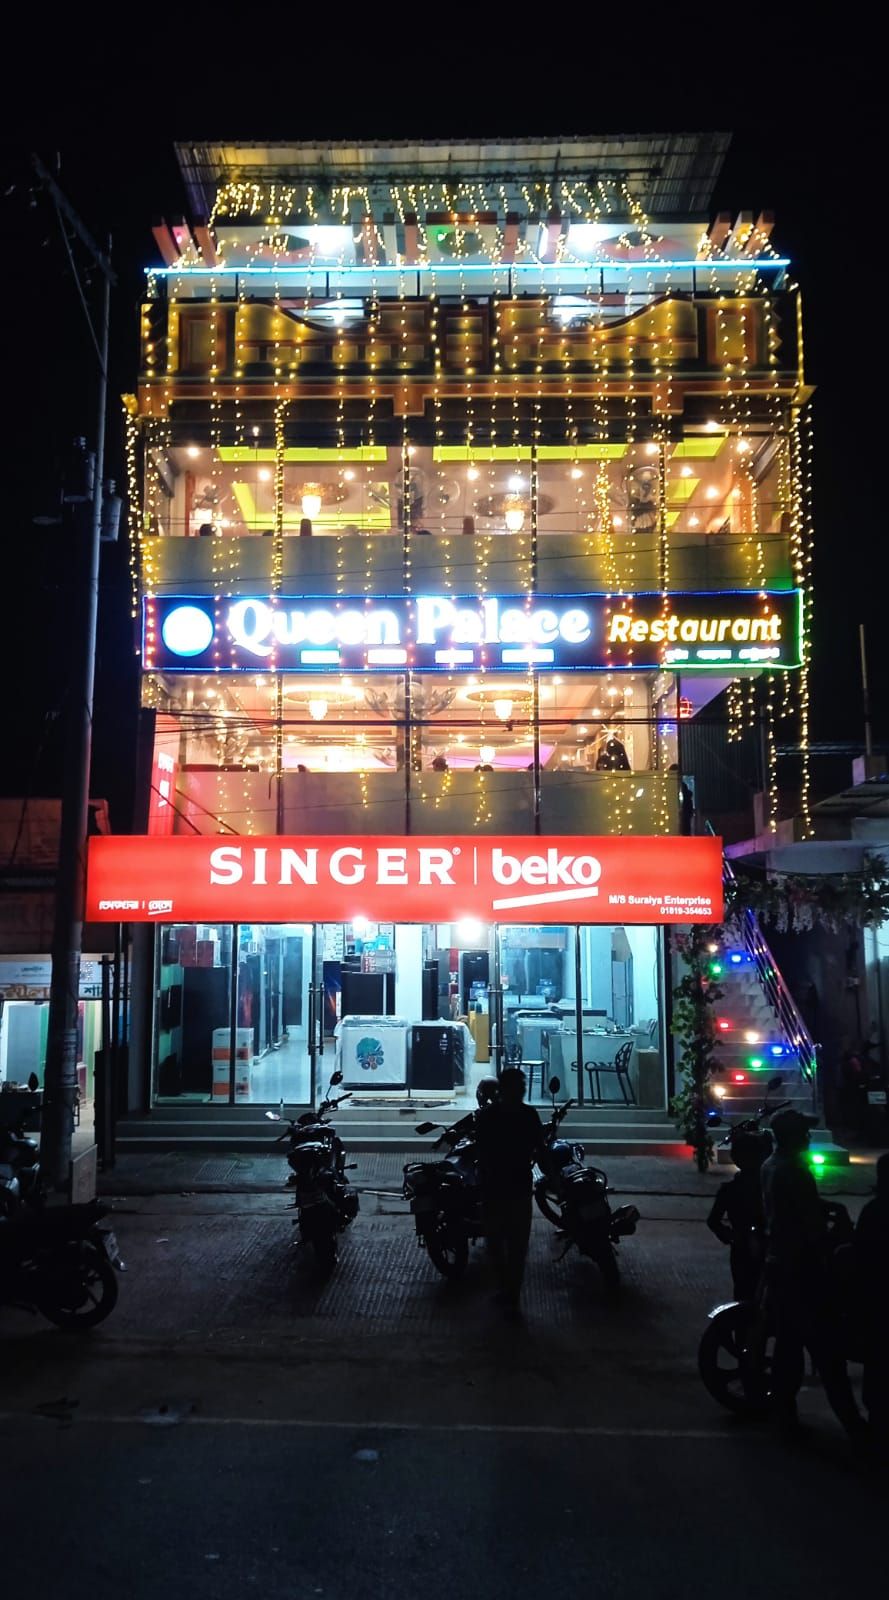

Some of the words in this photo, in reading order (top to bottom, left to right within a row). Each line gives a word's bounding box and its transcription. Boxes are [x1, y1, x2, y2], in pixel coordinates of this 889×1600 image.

[229, 599, 400, 656] Queen
[416, 597, 590, 644] Palace
[609, 615, 782, 642] Restaurant
[210, 846, 457, 884] SINGER
[492, 848, 601, 884] beko
[608, 895, 626, 904] M/S
[664, 896, 711, 906] Enterprise
